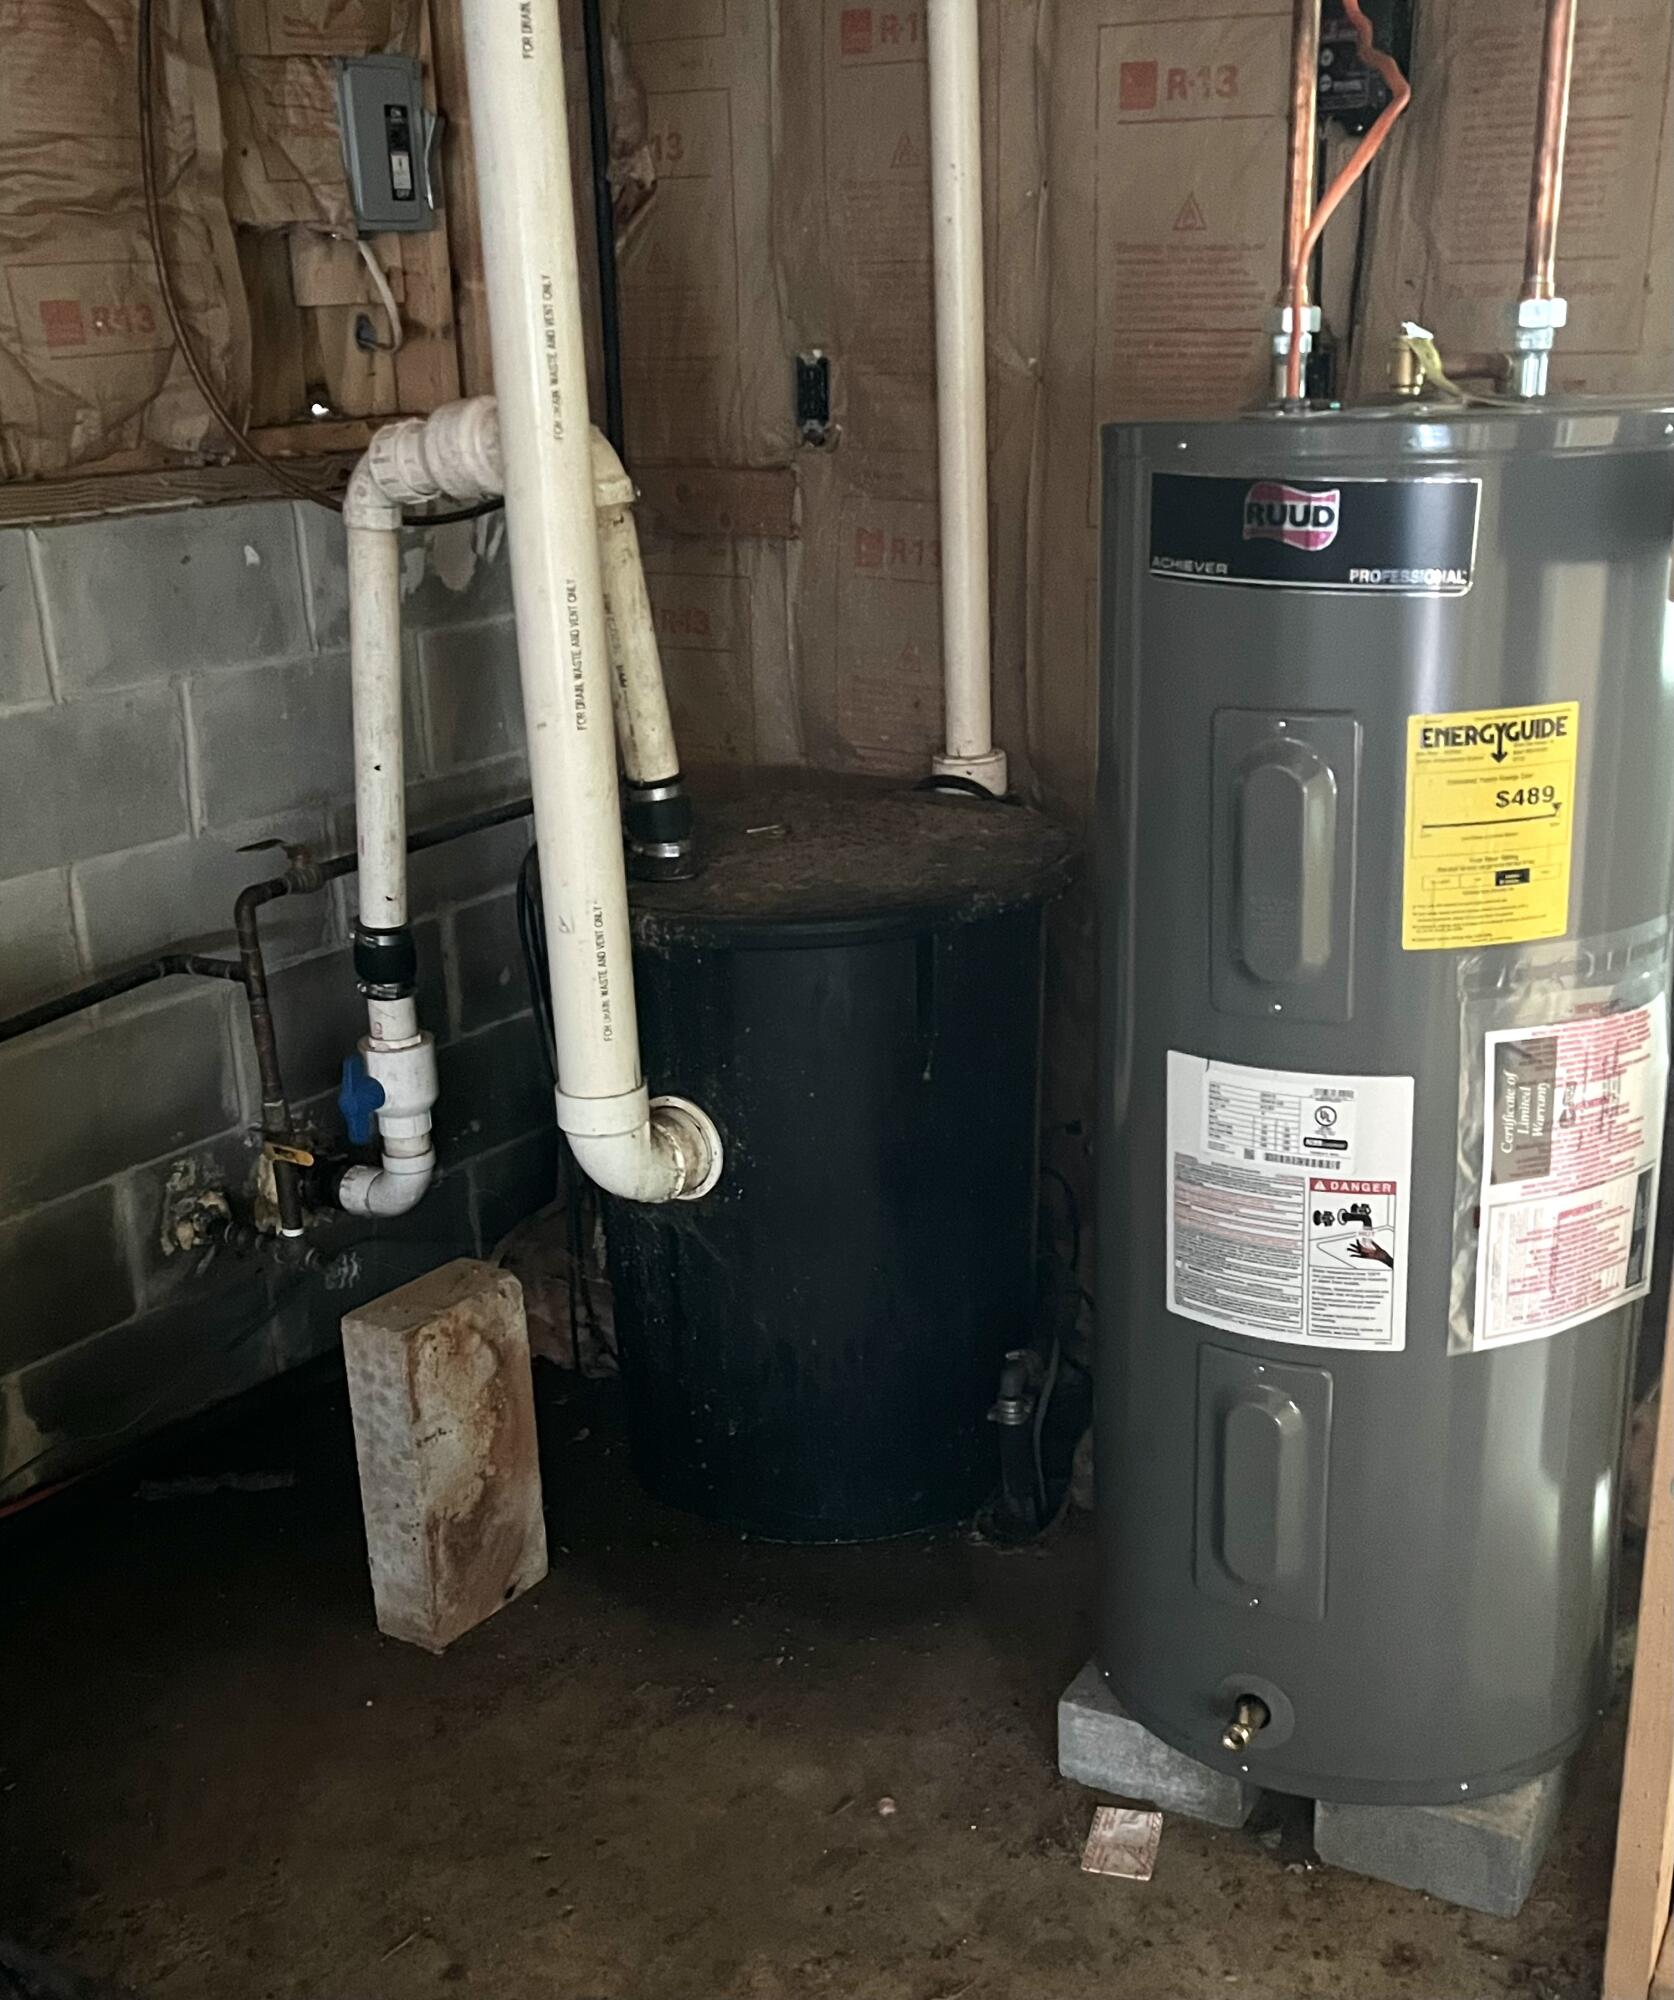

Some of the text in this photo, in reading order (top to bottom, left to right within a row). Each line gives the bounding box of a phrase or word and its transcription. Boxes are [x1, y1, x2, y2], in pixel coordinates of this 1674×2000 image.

[521, 36, 534, 59] FOR
[1165, 64, 1239, 100] R-13
[543, 303, 555, 327] VENT
[545, 329, 557, 350] AND
[547, 352, 559, 386] WASTE
[1246, 503, 1335, 527] RUUD
[1152, 556, 1228, 575] ACHIEVER
[1350, 568, 1468, 585] PROFESSIONAL
[566, 579, 577, 603] ONLY
[567, 605, 579, 628] VENT
[569, 629, 581, 648] AND
[571, 650, 583, 680] WASTE
[576, 711, 588, 731] FOR
[1421, 715, 1568, 750] ENERGYGUIDE
[593, 906, 604, 928] ONLY
[594, 929, 606, 950] VENT
[596, 951, 608, 968] AND
[598, 970, 609, 997] WASTE
[1501, 1069, 1519, 1153] Certificate of
[1517, 1086, 1531, 1134] Limited
[1330, 1181, 1392, 1193] DANGER
